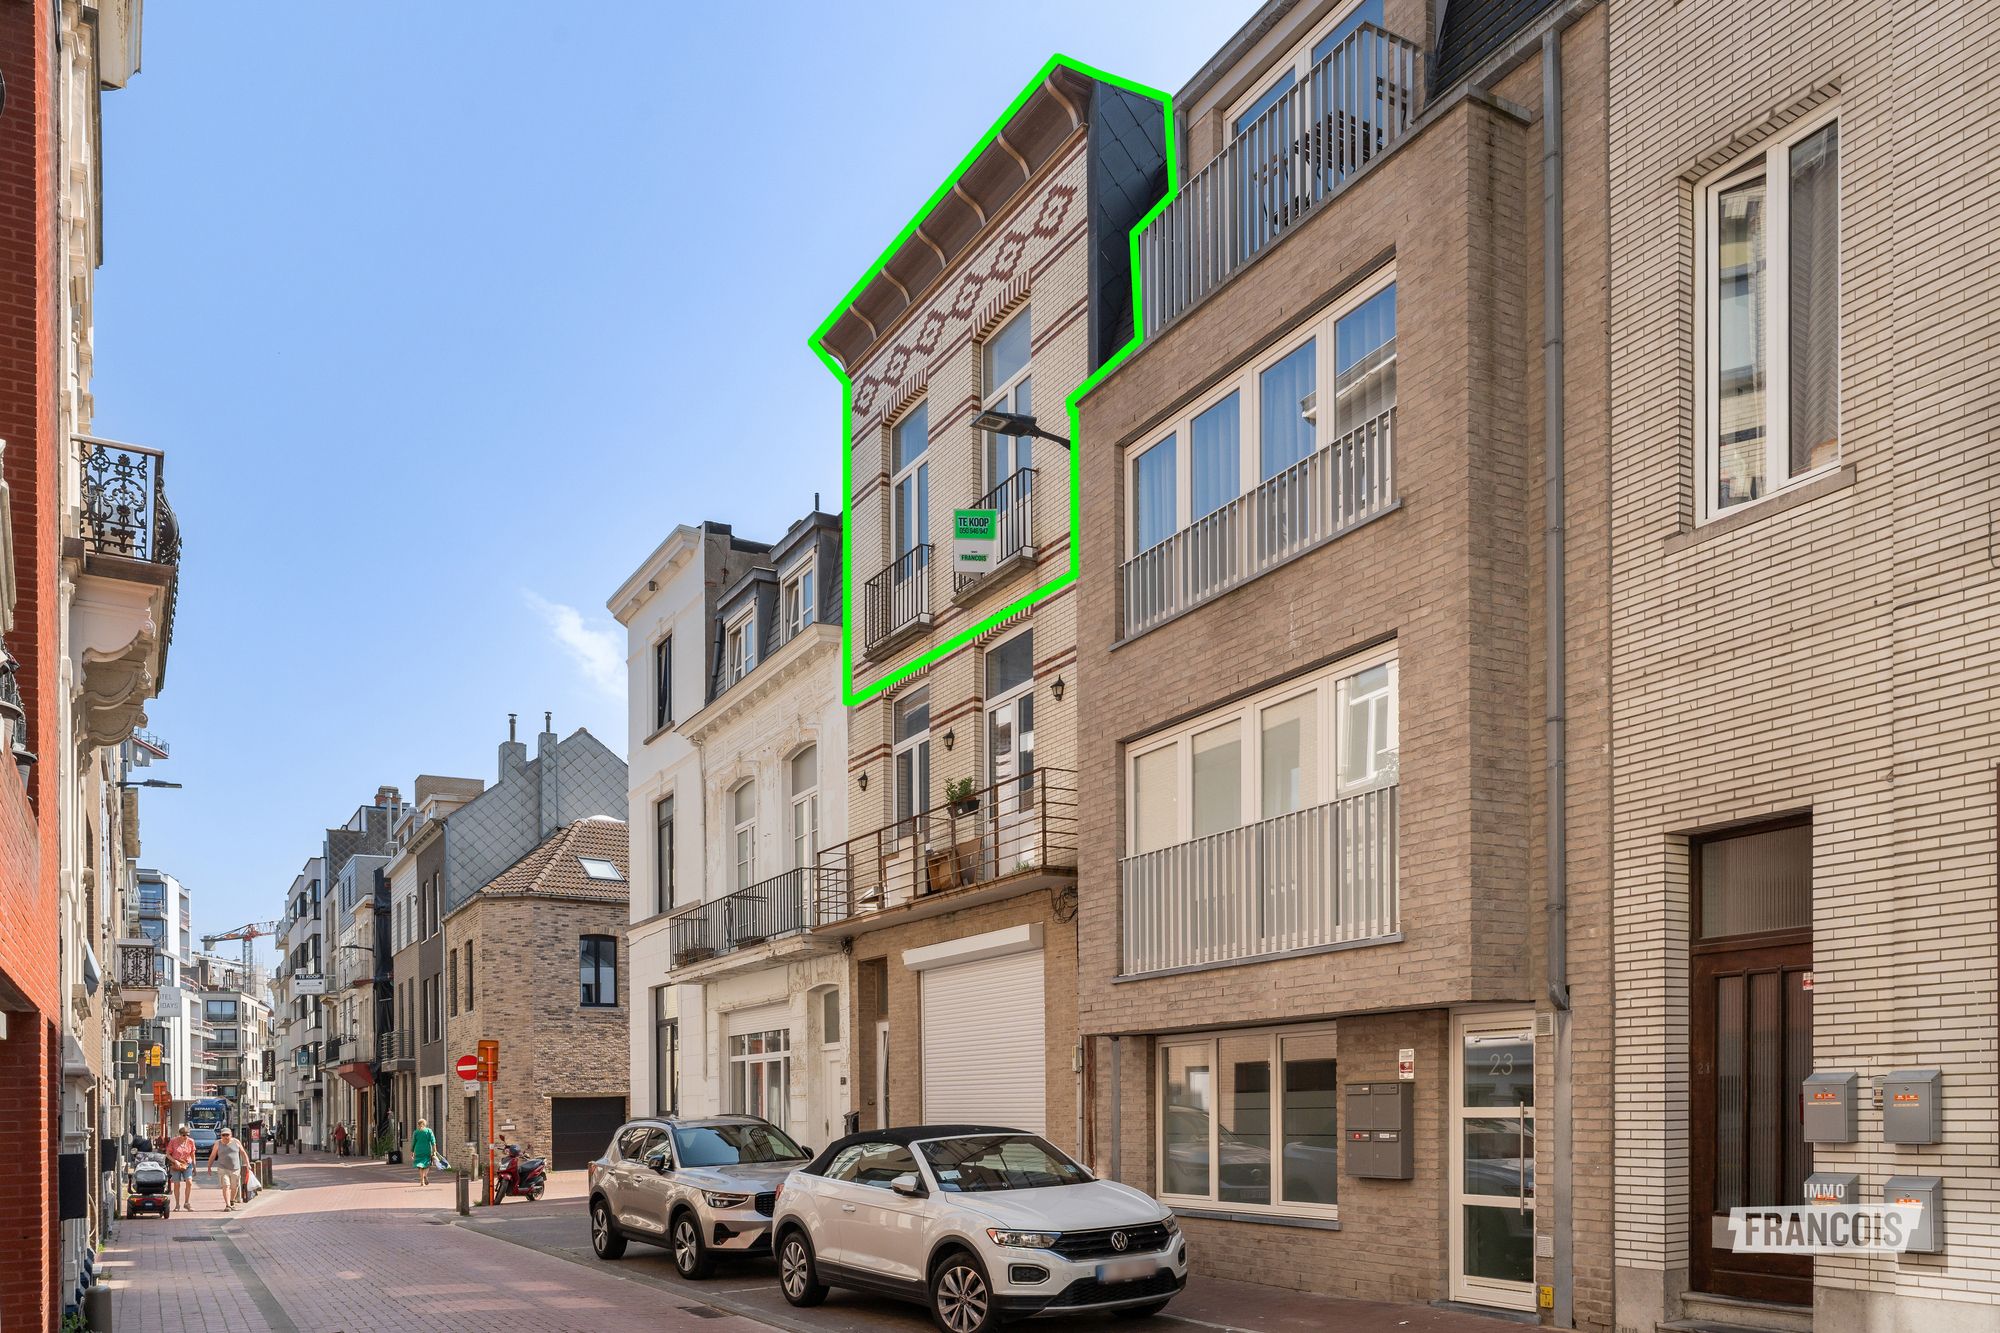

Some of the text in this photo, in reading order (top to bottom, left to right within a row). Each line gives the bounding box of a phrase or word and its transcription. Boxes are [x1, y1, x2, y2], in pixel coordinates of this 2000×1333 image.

[958, 517, 989, 527] TE KOOP
[961, 554, 987, 562] FRANCOIS
[1489, 1053, 1514, 1076] 23
[1697, 1062, 1711, 1075] 21
